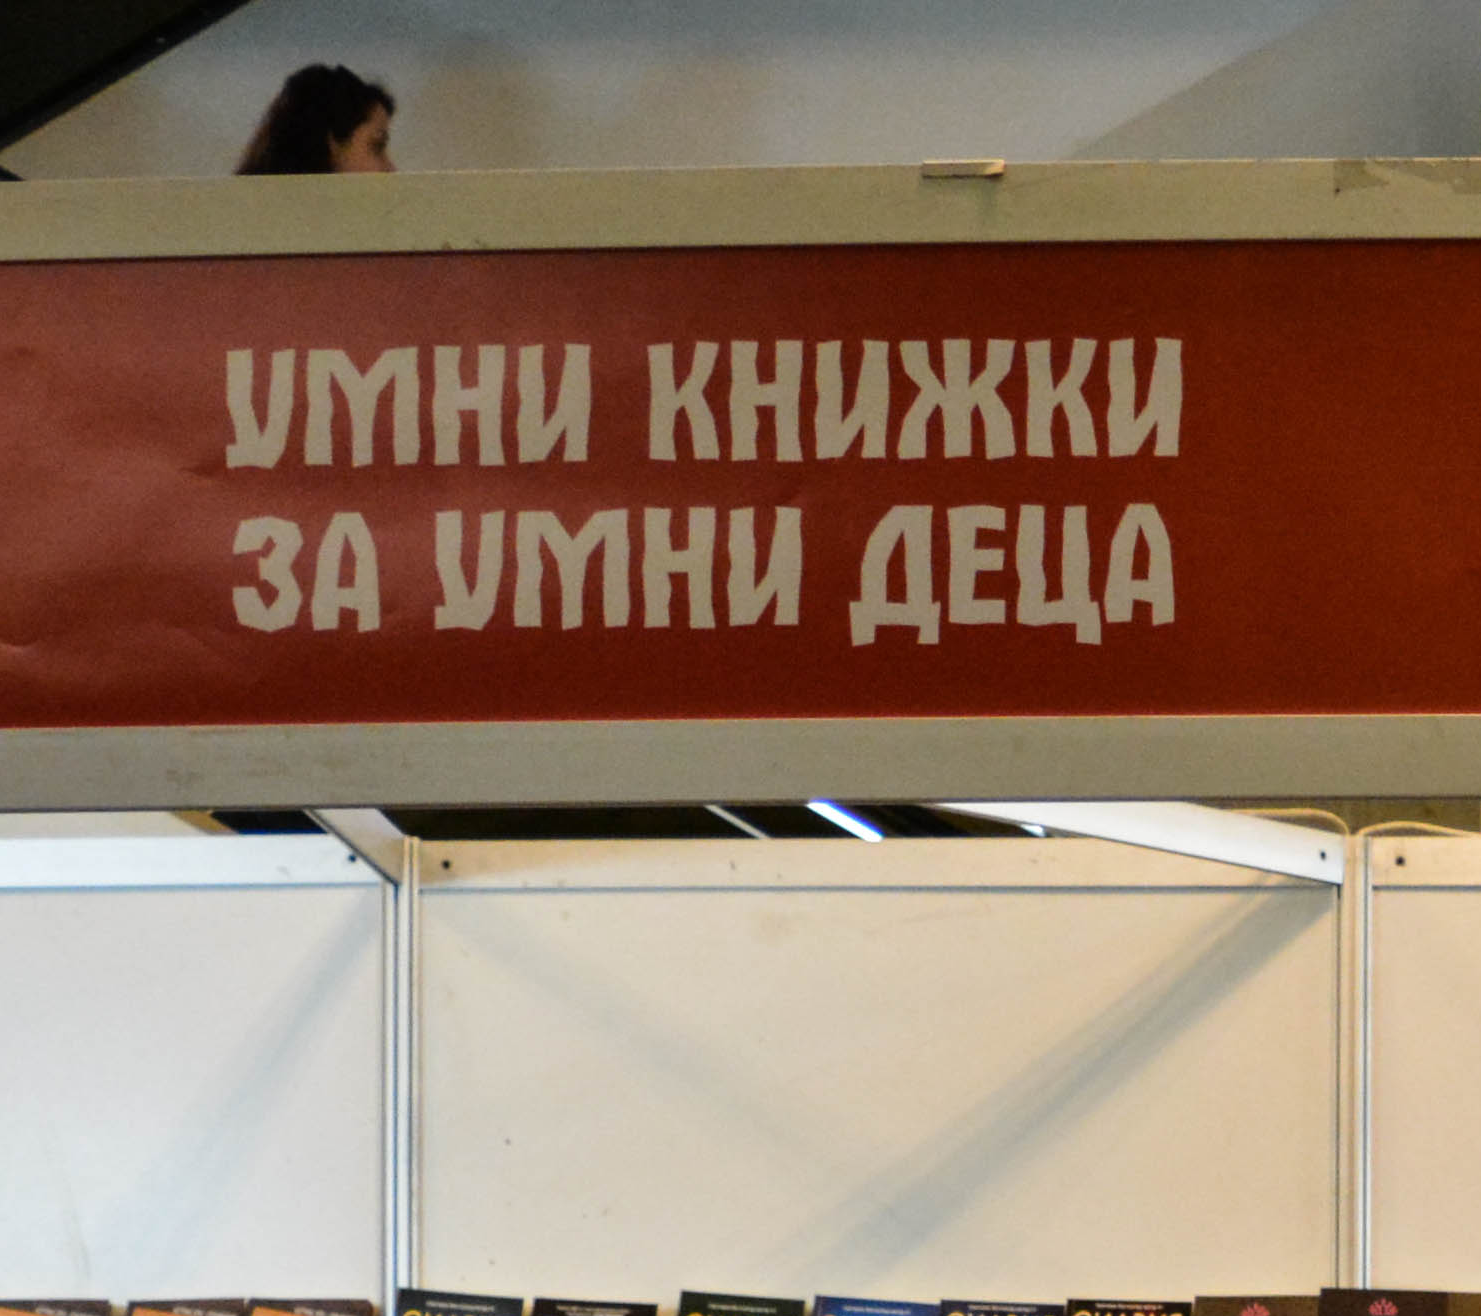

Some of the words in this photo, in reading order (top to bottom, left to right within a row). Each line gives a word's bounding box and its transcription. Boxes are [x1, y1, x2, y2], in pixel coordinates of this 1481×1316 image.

[225, 343, 591, 468] УМНИ
[647, 337, 1183, 462] КНИЖКИ
[231, 511, 381, 632] ЗА
[433, 506, 802, 632] УМНИ
[849, 503, 1175, 647] ДЕЦА
